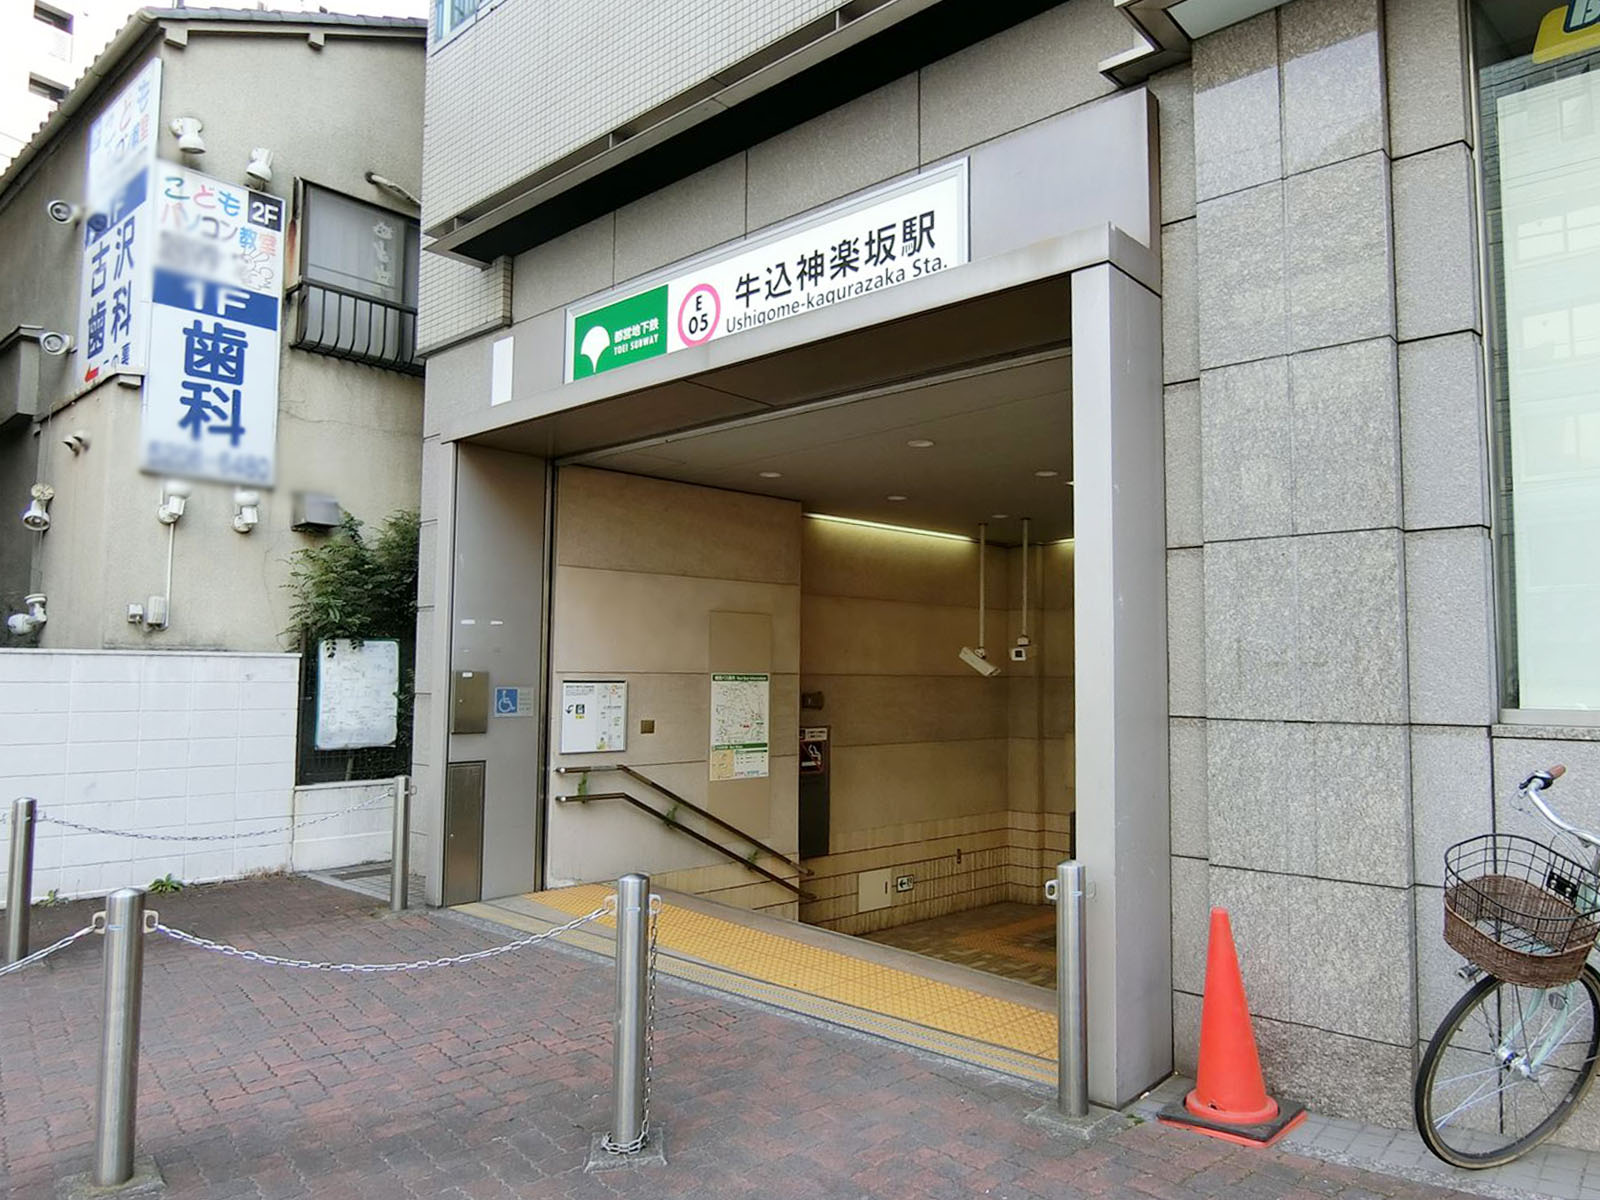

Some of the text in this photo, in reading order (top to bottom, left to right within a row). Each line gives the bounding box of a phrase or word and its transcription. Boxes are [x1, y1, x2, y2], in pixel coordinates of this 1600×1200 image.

[164, 176, 241, 217] こども
[252, 201, 279, 226] 2F
[735, 209, 936, 309] 牛込神楽坂駅
[184, 280, 251, 316] 1F
[695, 295, 703, 312] E
[726, 256, 948, 334] Ushigome-kagurazaka Sta.
[630, 333, 659, 351] SUBWAY
[688, 313, 709, 335] 05
[178, 319, 249, 447] 歯科
